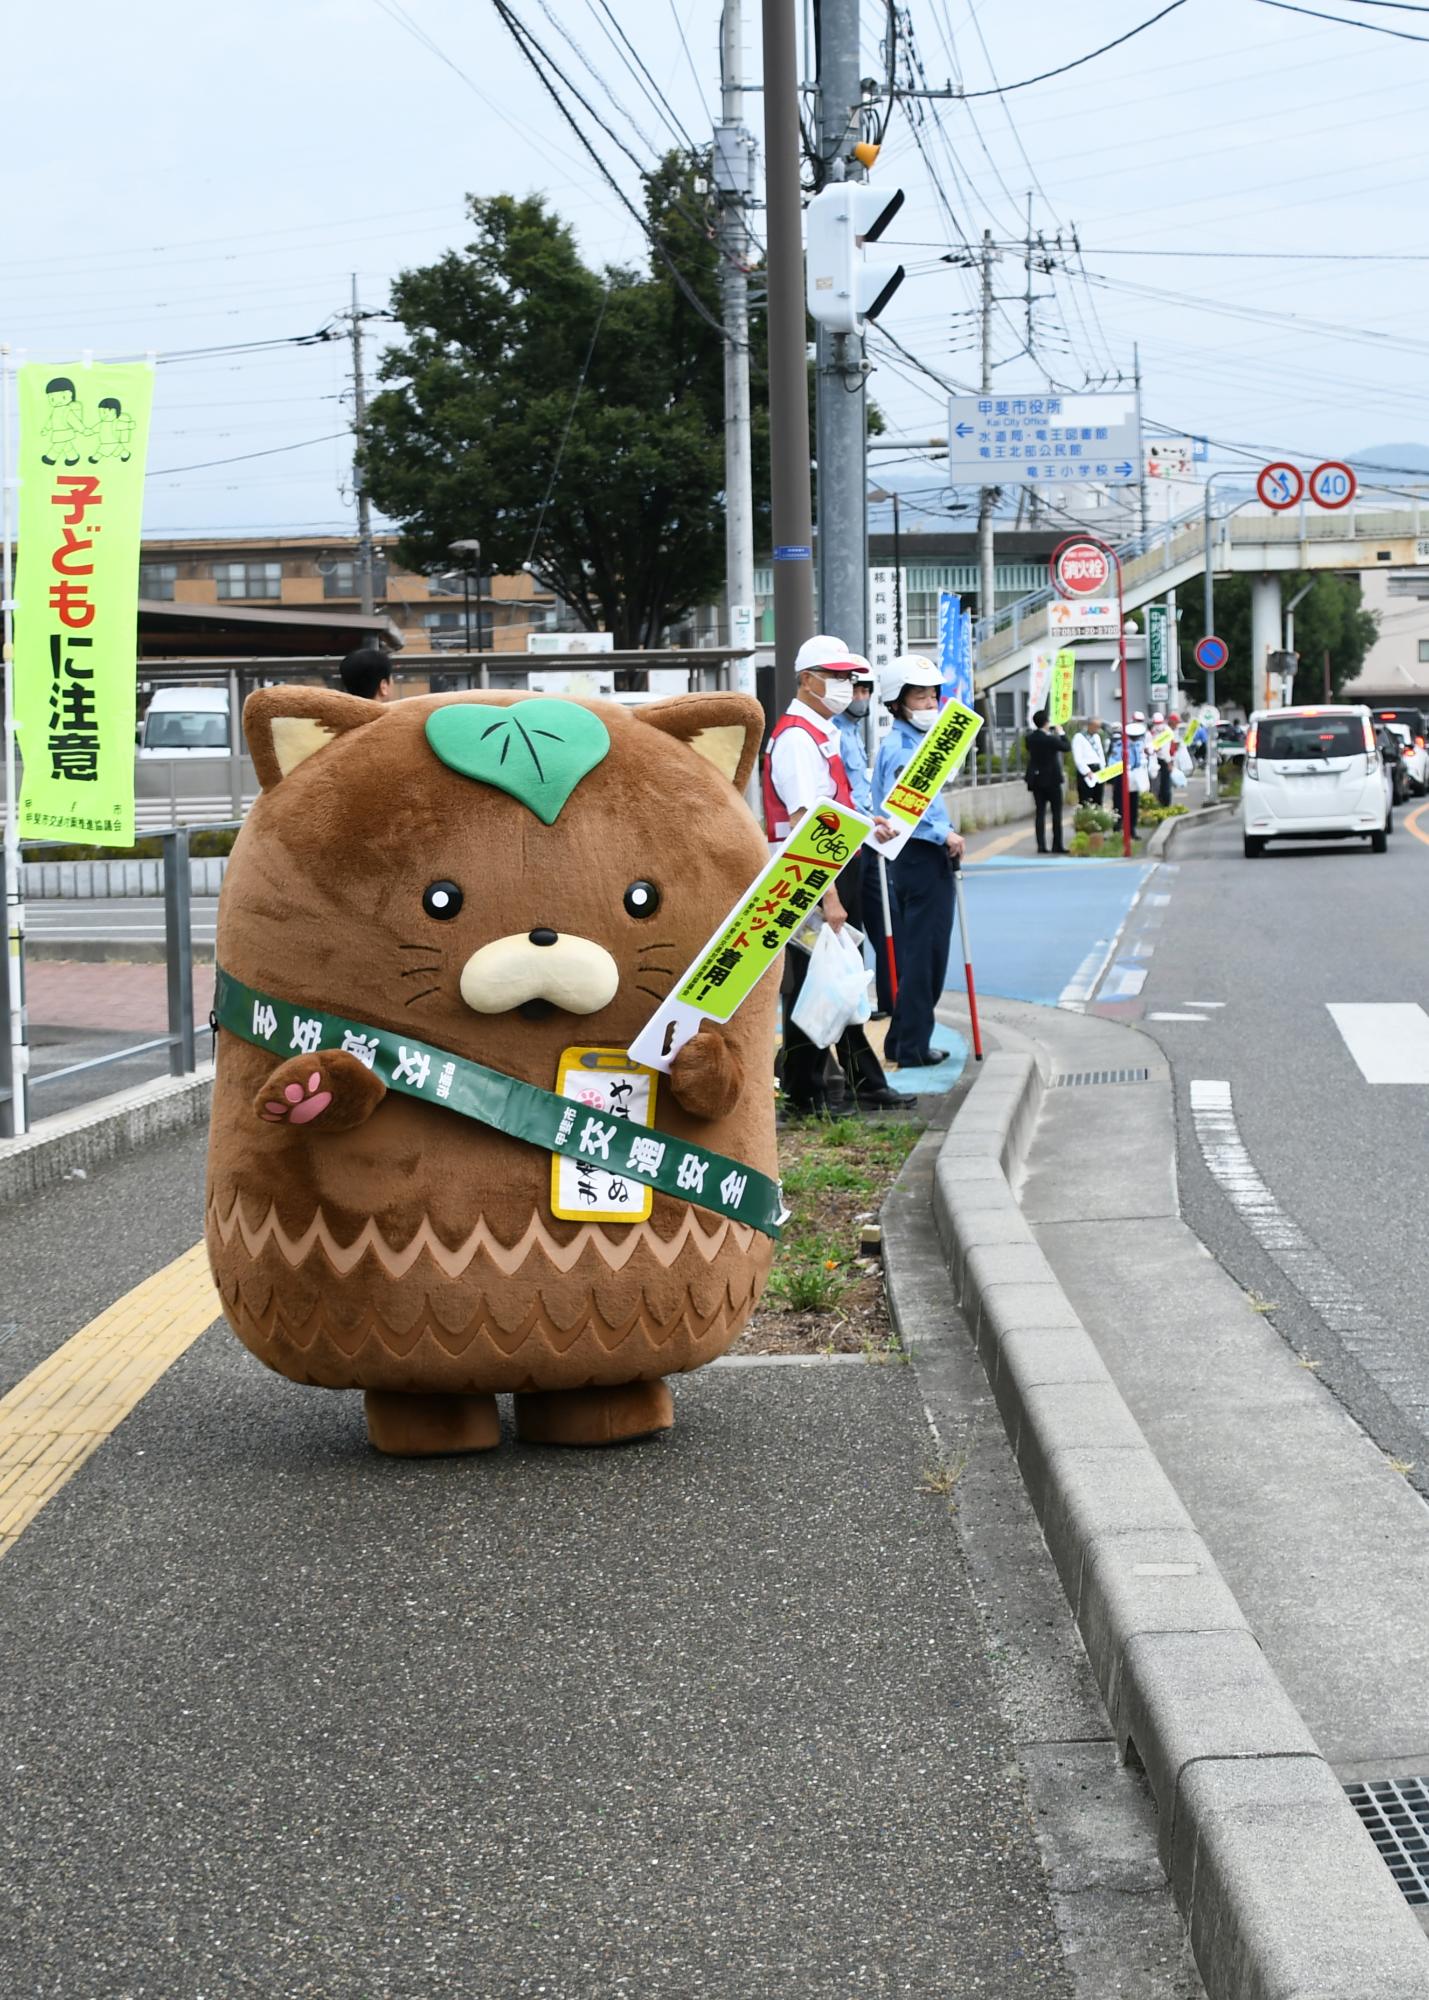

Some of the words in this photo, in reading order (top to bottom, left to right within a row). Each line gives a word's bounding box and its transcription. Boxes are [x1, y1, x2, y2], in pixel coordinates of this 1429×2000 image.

[978, 399, 1061, 416] 甲斐市役所
[987, 419, 1001, 427] Kai
[1003, 418, 1021, 428] City
[1023, 417, 1048, 427] Office
[1026, 465, 1109, 478] 竜王小学校
[1320, 475, 1346, 496] 40
[1063, 557, 1105, 579] 消火栓
[48, 475, 103, 782] 子どもに注意
[908, 711, 973, 793] 交通安全運動
[761, 868, 830, 950] 自転車も
[435, 1061, 456, 1100] 甲斐市
[554, 1106, 577, 1147] 甲斐市
[578, 1116, 748, 1210] 交通安全
